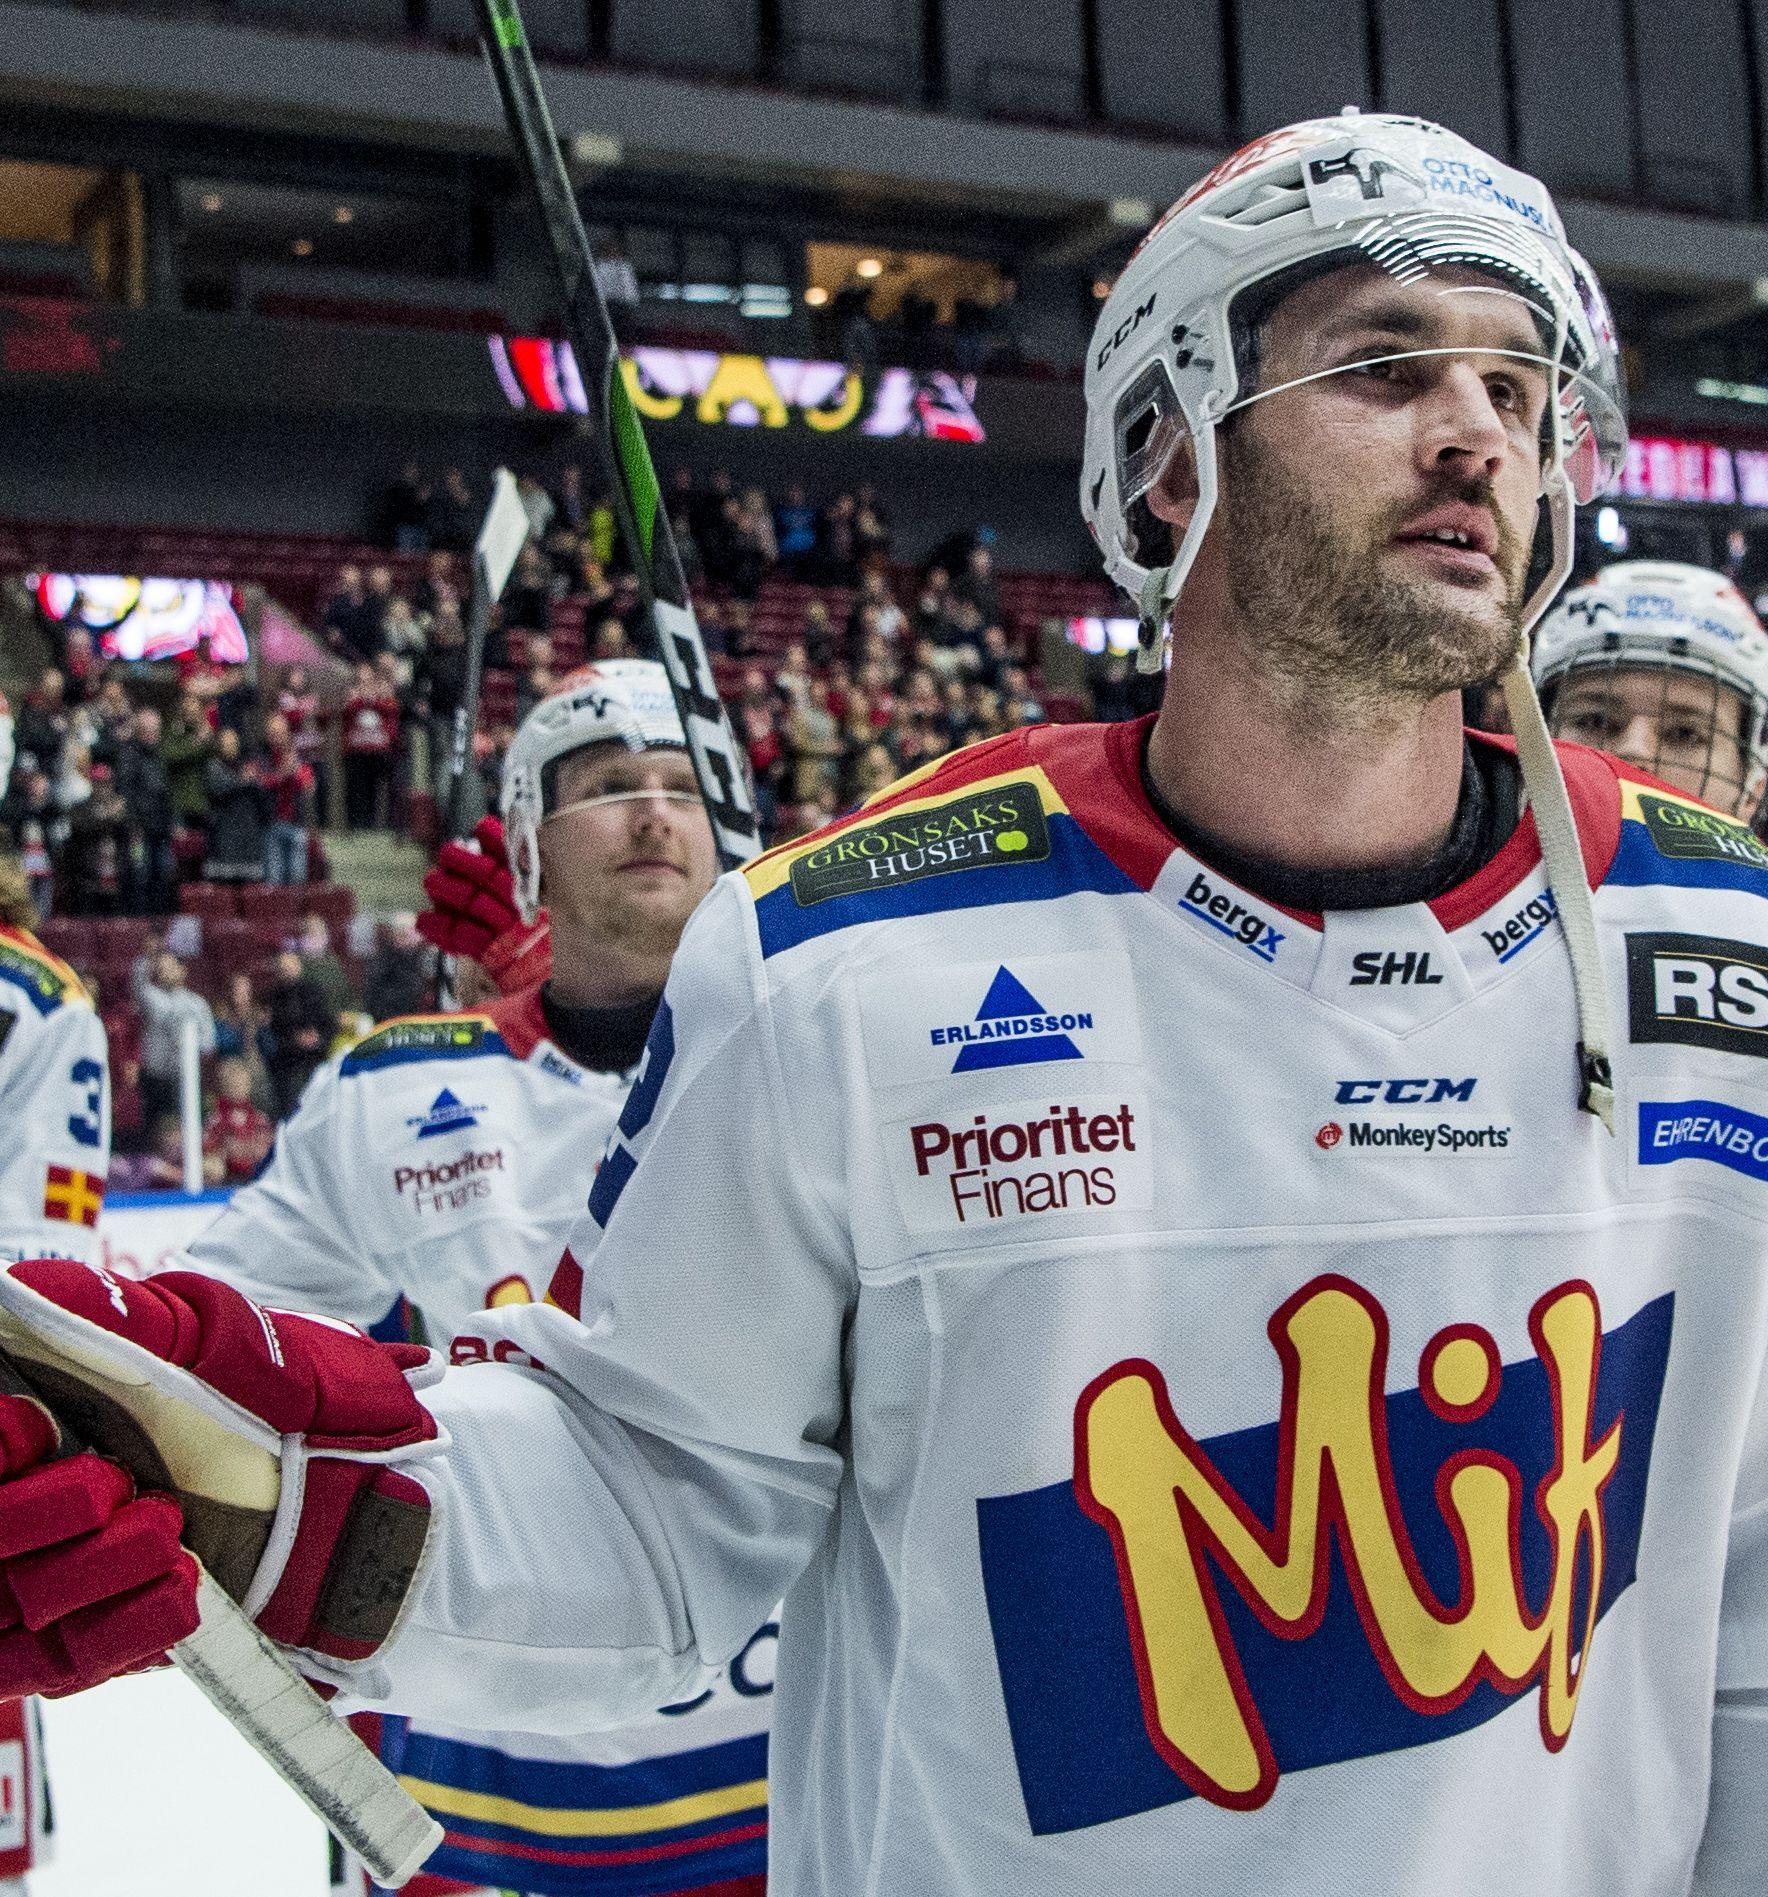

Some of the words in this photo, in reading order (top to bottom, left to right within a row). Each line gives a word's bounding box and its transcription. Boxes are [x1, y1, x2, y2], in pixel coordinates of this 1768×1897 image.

[1422, 157, 1493, 186] OTTO
[1430, 175, 1554, 232] MAGNUS
[1097, 291, 1158, 373] CCM
[807, 799, 1020, 873] GRÖNSAKS
[867, 829, 995, 881] HUSET
[1185, 872, 1287, 955] bergx
[1349, 951, 1444, 986] SHL
[930, 1012, 1094, 1047] ERLANDSSON
[1334, 1077, 1478, 1105] CCM
[910, 1103, 1137, 1176] Prioritet
[1350, 1122, 1509, 1152] MonkeySports
[394, 1148, 505, 1195] Prioritet
[949, 1164, 1117, 1222] Finans
[1072, 1272, 1625, 1812] Mif
